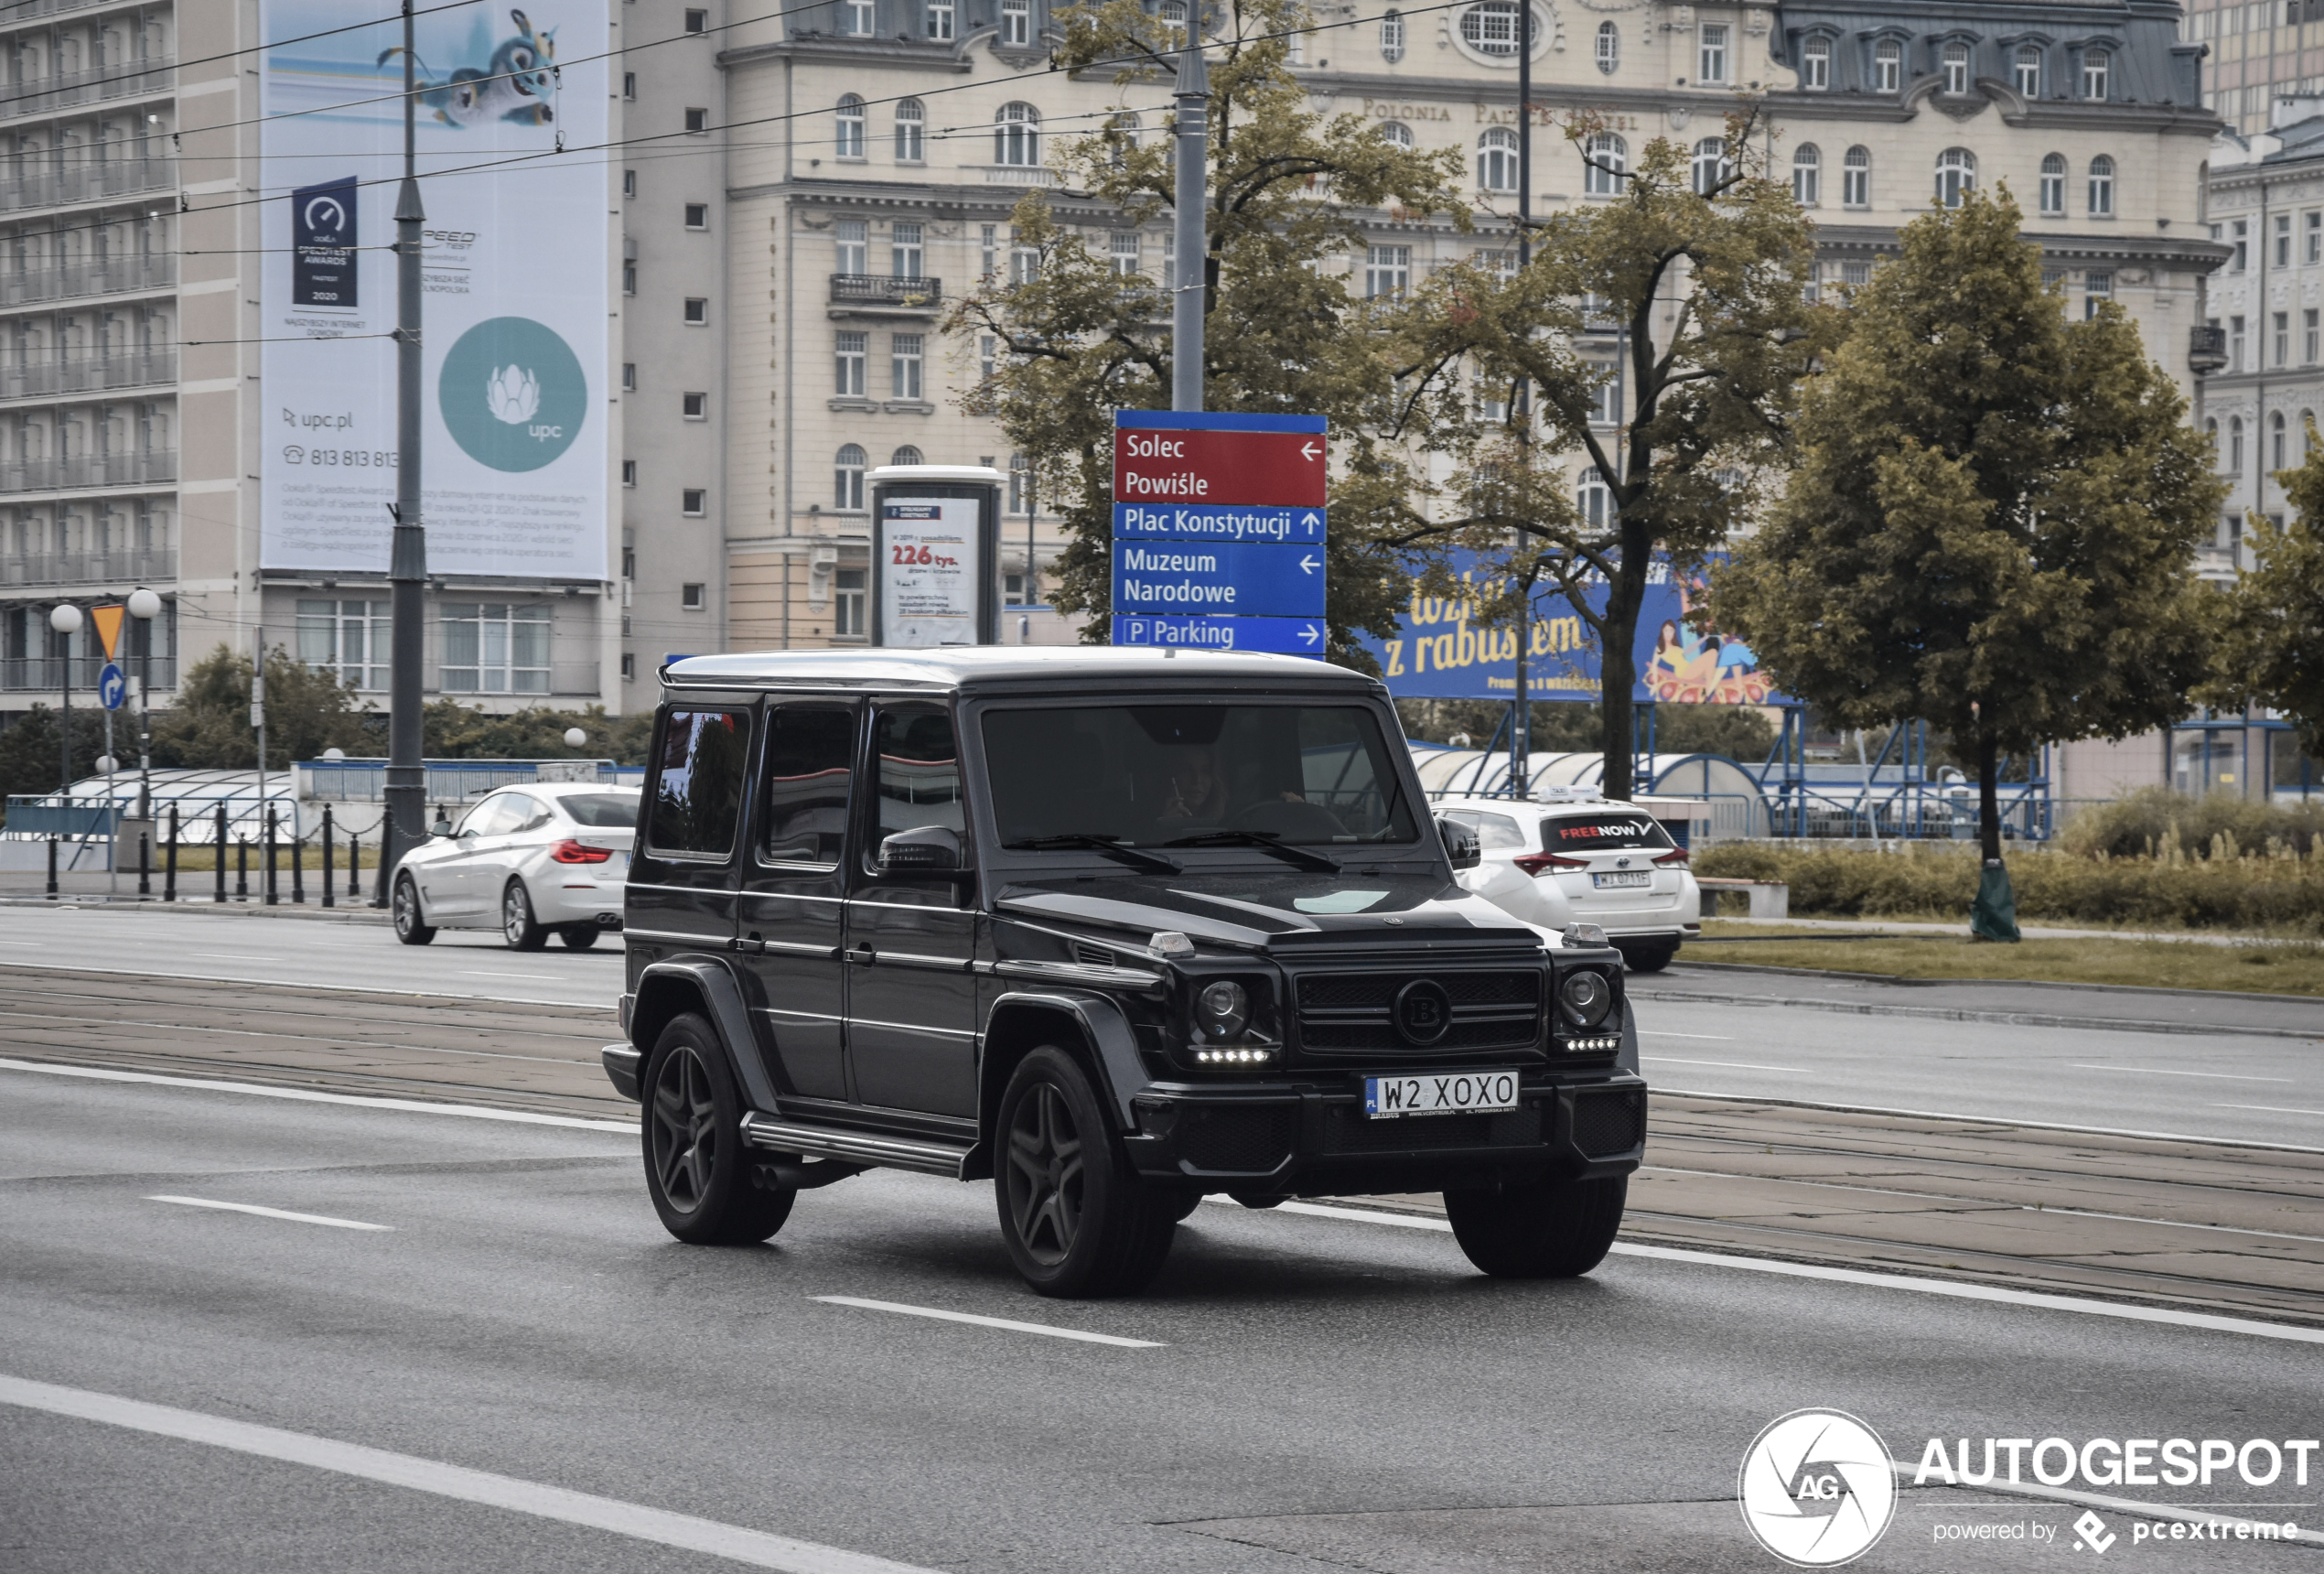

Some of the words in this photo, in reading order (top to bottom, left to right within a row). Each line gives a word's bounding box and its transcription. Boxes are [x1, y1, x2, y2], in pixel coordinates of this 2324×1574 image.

[1362, 97, 1451, 122] POLONIA
[304, 256, 347, 265] AWARDS
[312, 292, 339, 301] 2020
[302, 412, 353, 432] upc.pl
[528, 424, 562, 442] upc
[1126, 435, 1185, 458] Solec
[311, 449, 338, 466] 813
[342, 450, 370, 467] 813
[373, 451, 399, 468] 813
[1125, 471, 1208, 495] Powiśle
[1124, 508, 1169, 531] Plac
[1175, 510, 1290, 540] Konstytucji
[892, 545, 932, 566] 226
[1124, 548, 1216, 572] Muzeum
[1124, 578, 1236, 602] Narodowe
[1130, 621, 1144, 641] P
[1155, 620, 1234, 650] Parking
[1385, 640, 1405, 677] z
[1415, 615, 1584, 674] rabusem
[1559, 825, 1636, 840] FREENOW
[1410, 997, 1440, 1028] B
[1367, 1099, 1377, 1108] PL
[1384, 1080, 1421, 1110] W2
[1434, 1075, 1513, 1107] XOXO
[1370, 1112, 1400, 1120] BRABUS
